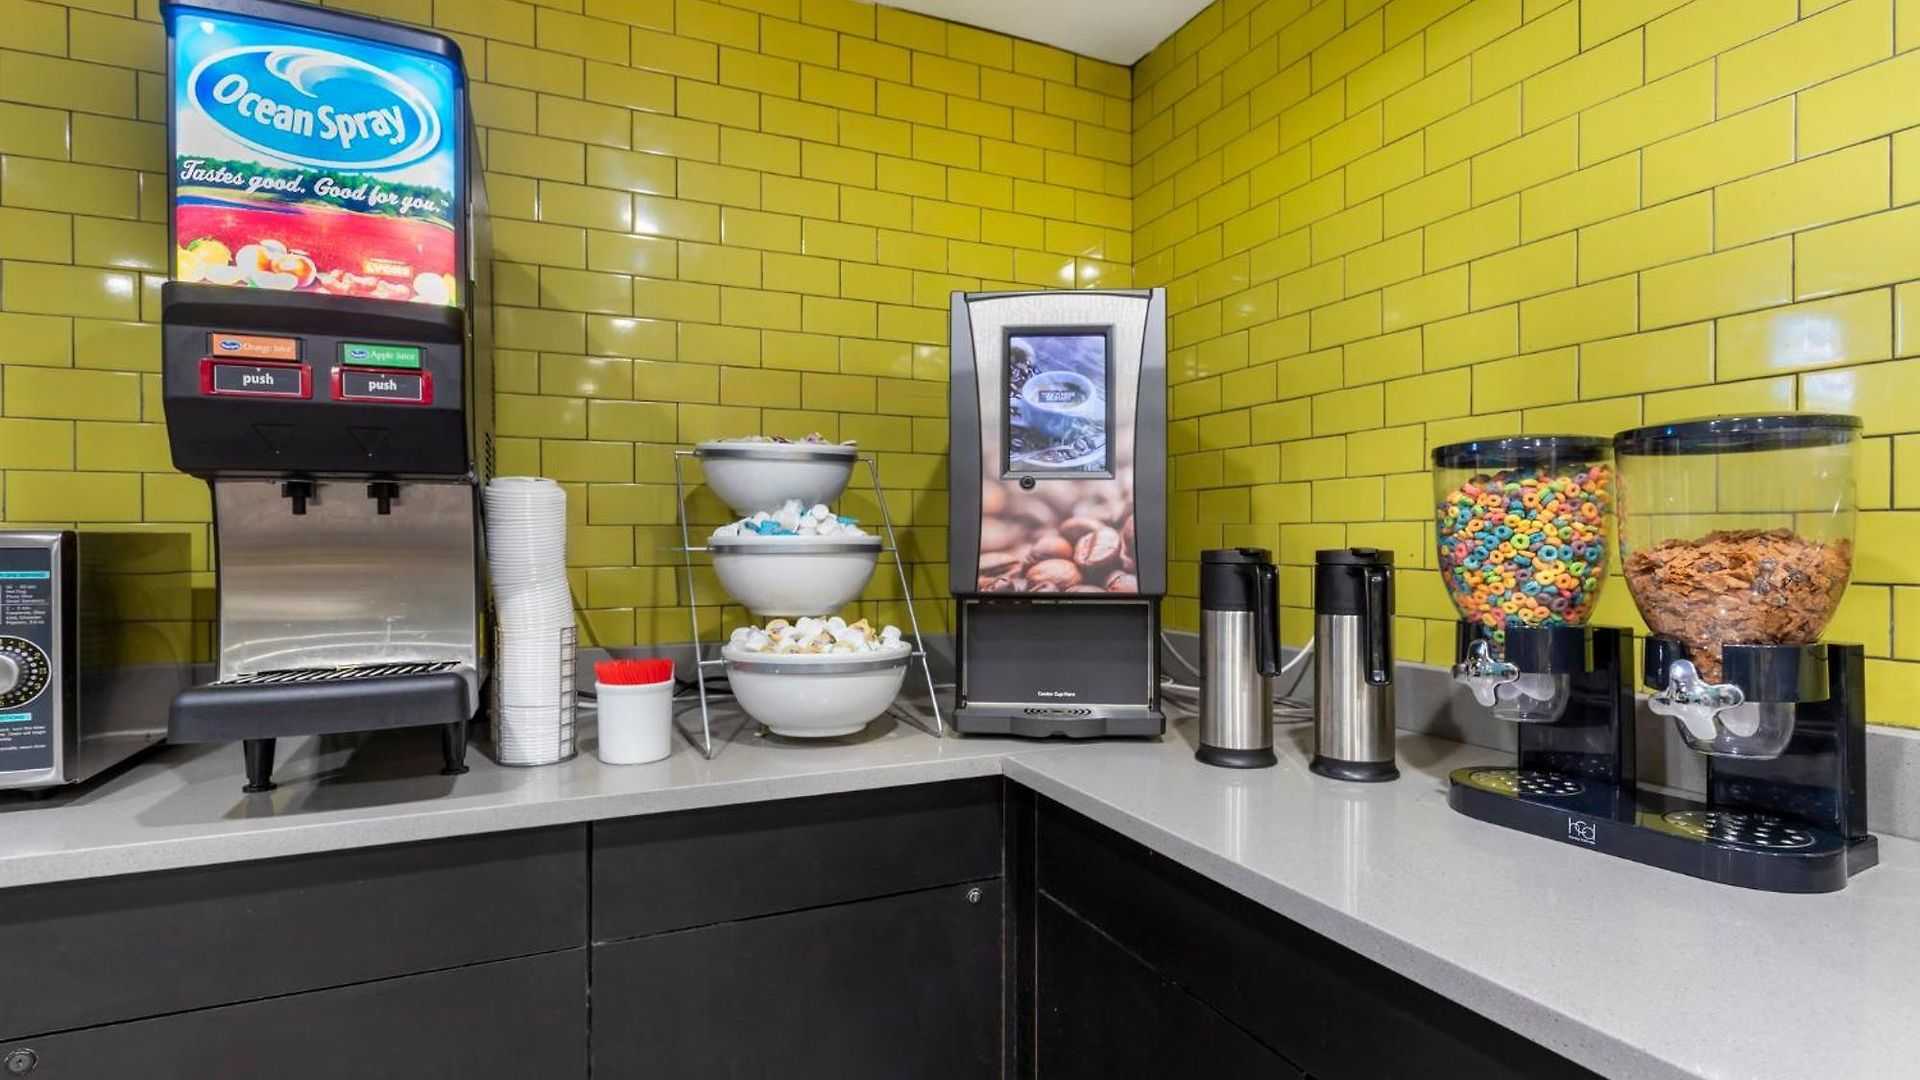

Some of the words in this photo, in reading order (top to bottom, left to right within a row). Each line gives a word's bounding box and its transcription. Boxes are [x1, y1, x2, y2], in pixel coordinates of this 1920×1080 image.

[213, 73, 312, 137] Ocean
[317, 104, 408, 149] Spray
[180, 160, 245, 185] Tastes
[248, 174, 306, 193] good.
[314, 177, 366, 200] Good
[368, 188, 400, 207] for
[242, 371, 275, 386] push
[368, 379, 398, 393] push
